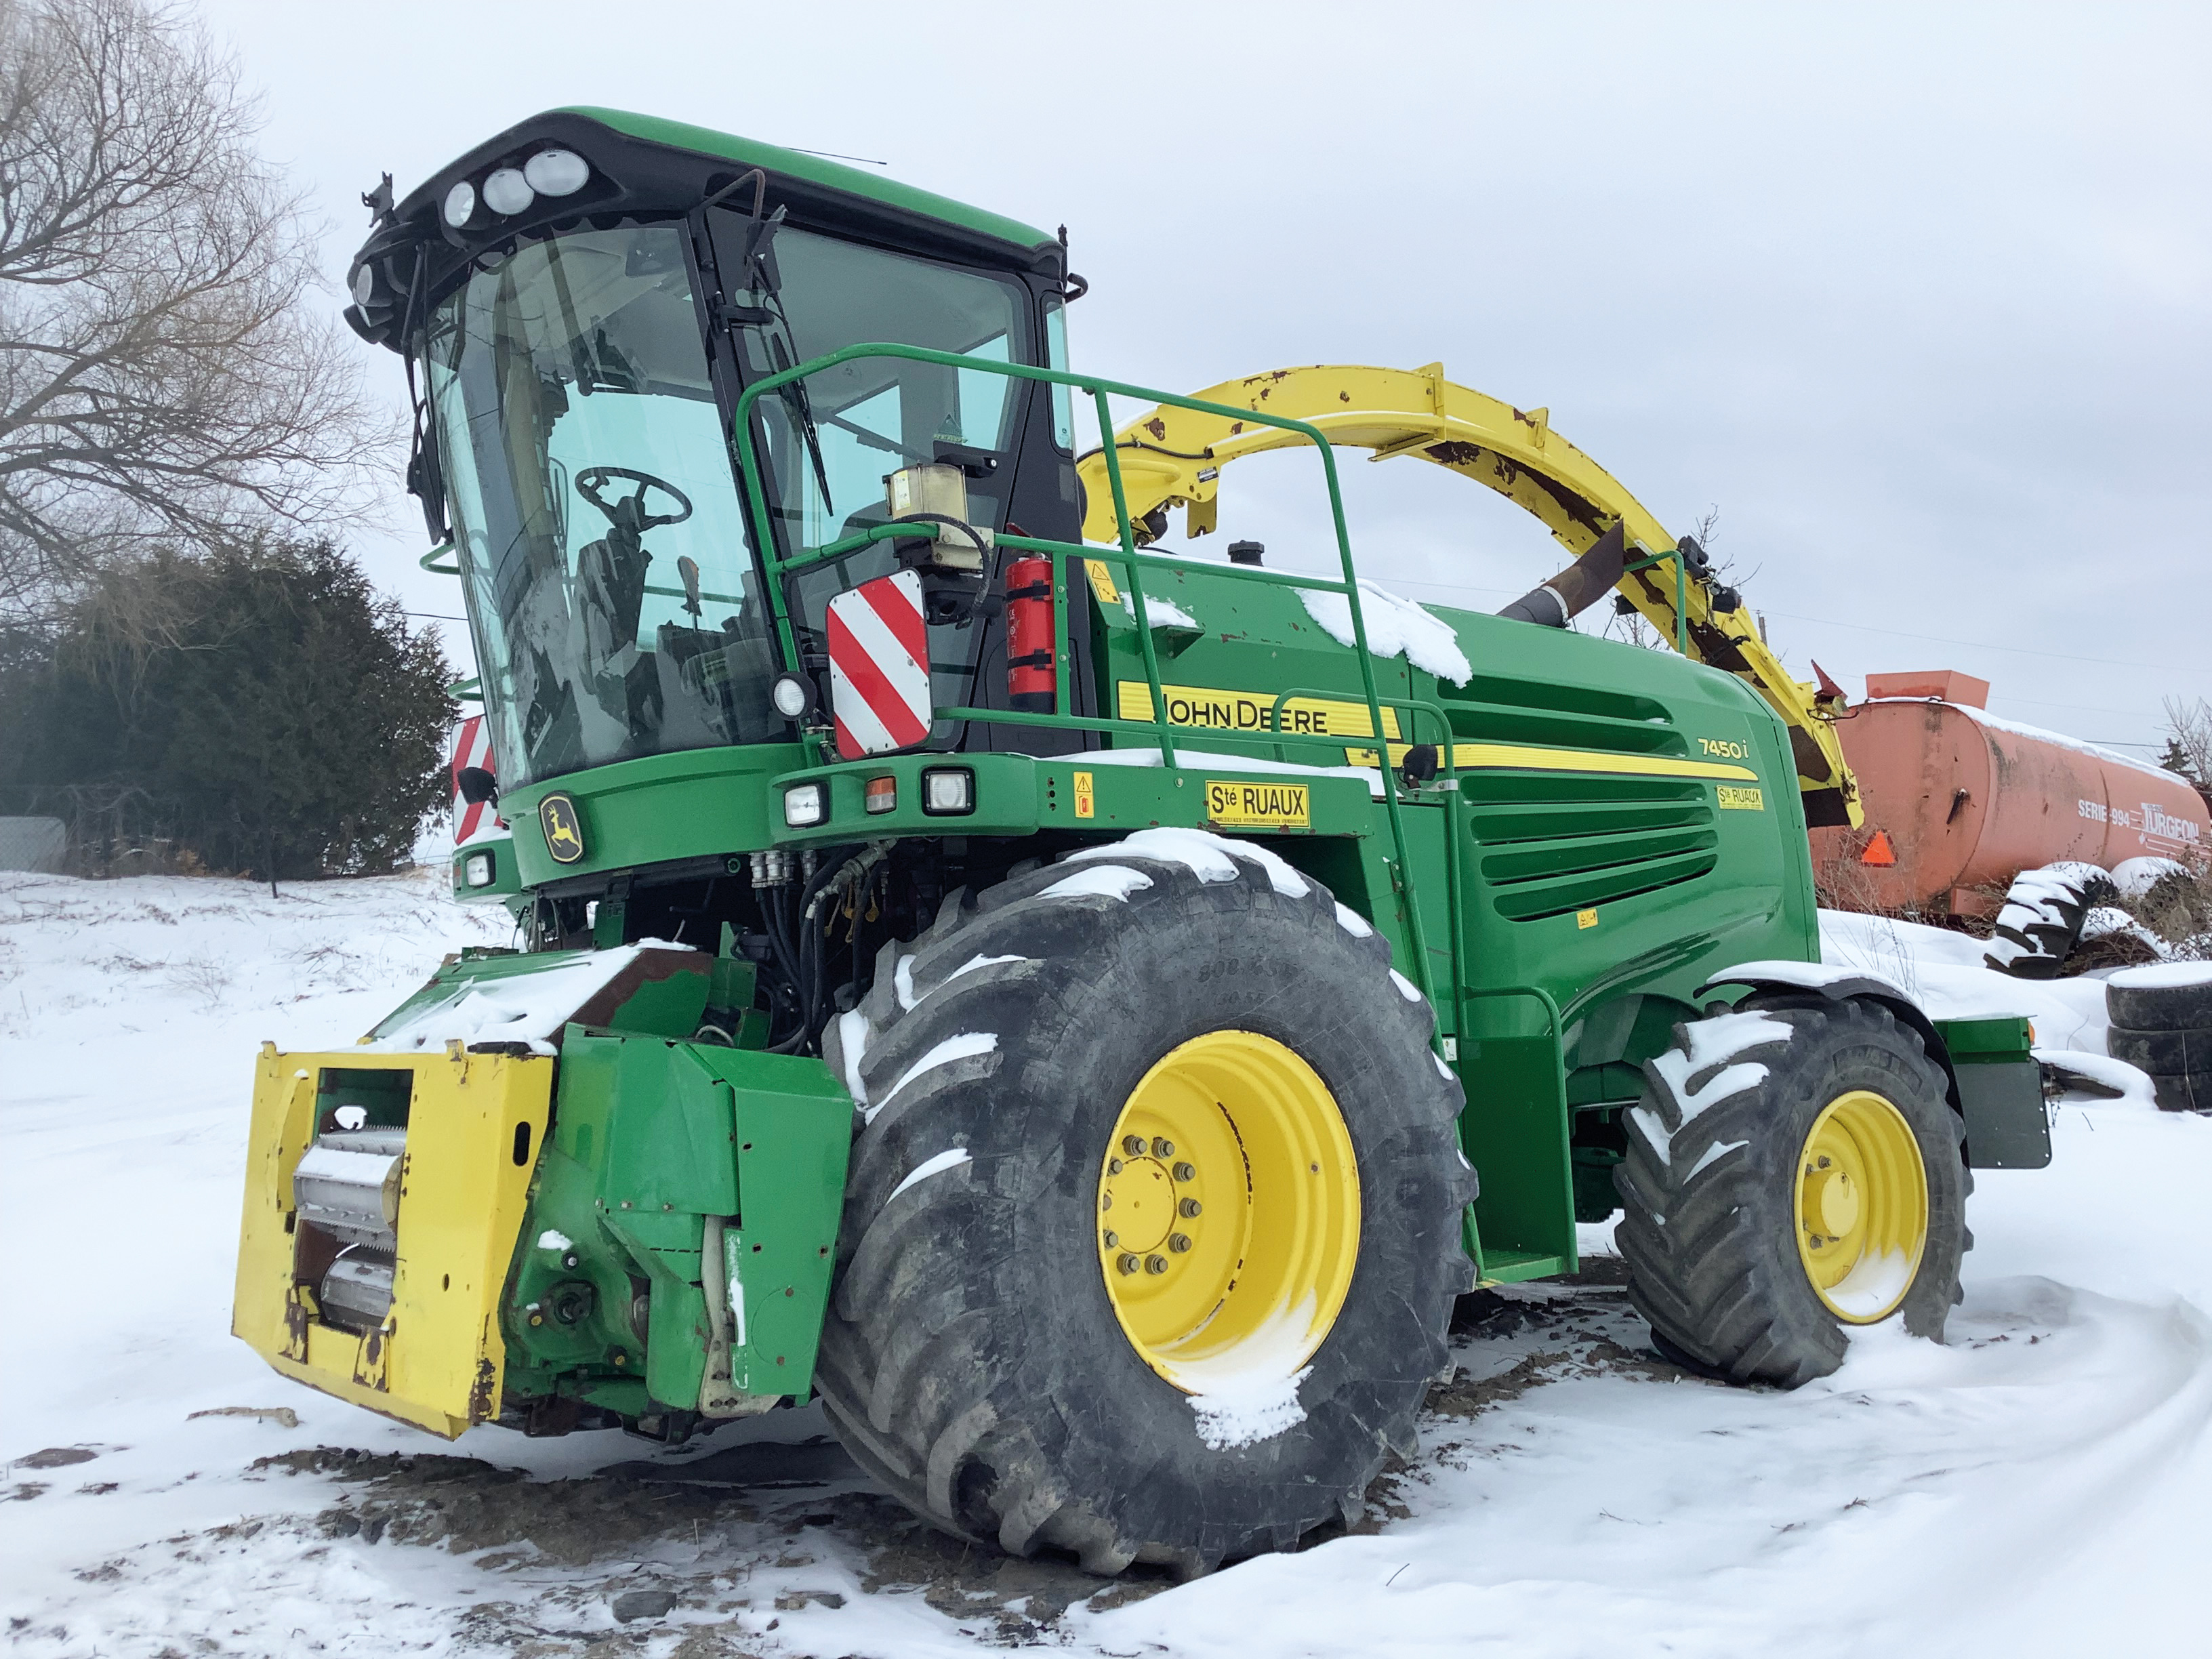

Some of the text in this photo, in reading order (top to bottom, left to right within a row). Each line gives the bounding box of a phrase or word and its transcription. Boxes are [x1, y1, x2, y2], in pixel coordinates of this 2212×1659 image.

[1237, 699, 1328, 733] DEERE
[1212, 785, 1305, 816] Sté RUAUX
[1732, 789, 1761, 804] RUAUX
